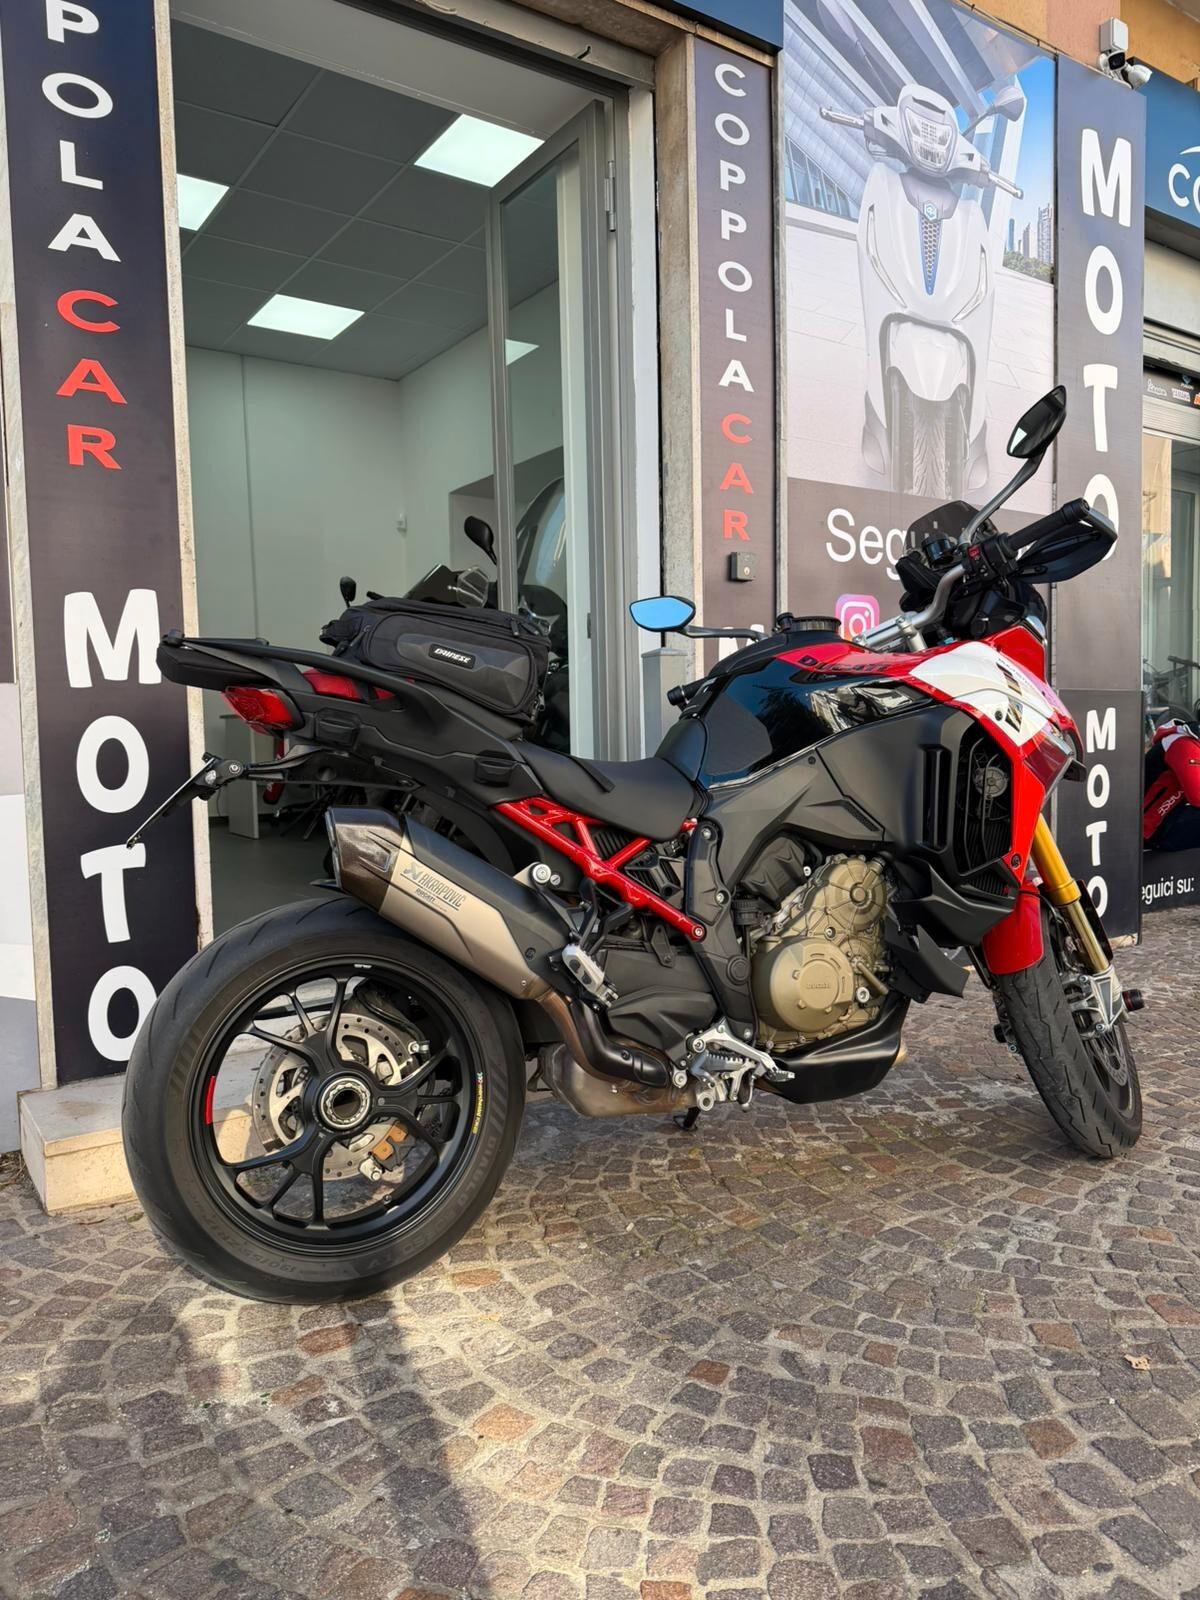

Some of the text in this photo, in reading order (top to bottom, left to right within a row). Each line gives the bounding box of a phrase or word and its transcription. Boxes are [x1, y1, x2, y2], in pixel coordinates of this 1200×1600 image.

[64, 588, 162, 1061] MOTO
[1086, 707, 1116, 918] MOTO
[1176, 877, 1195, 894] su:
